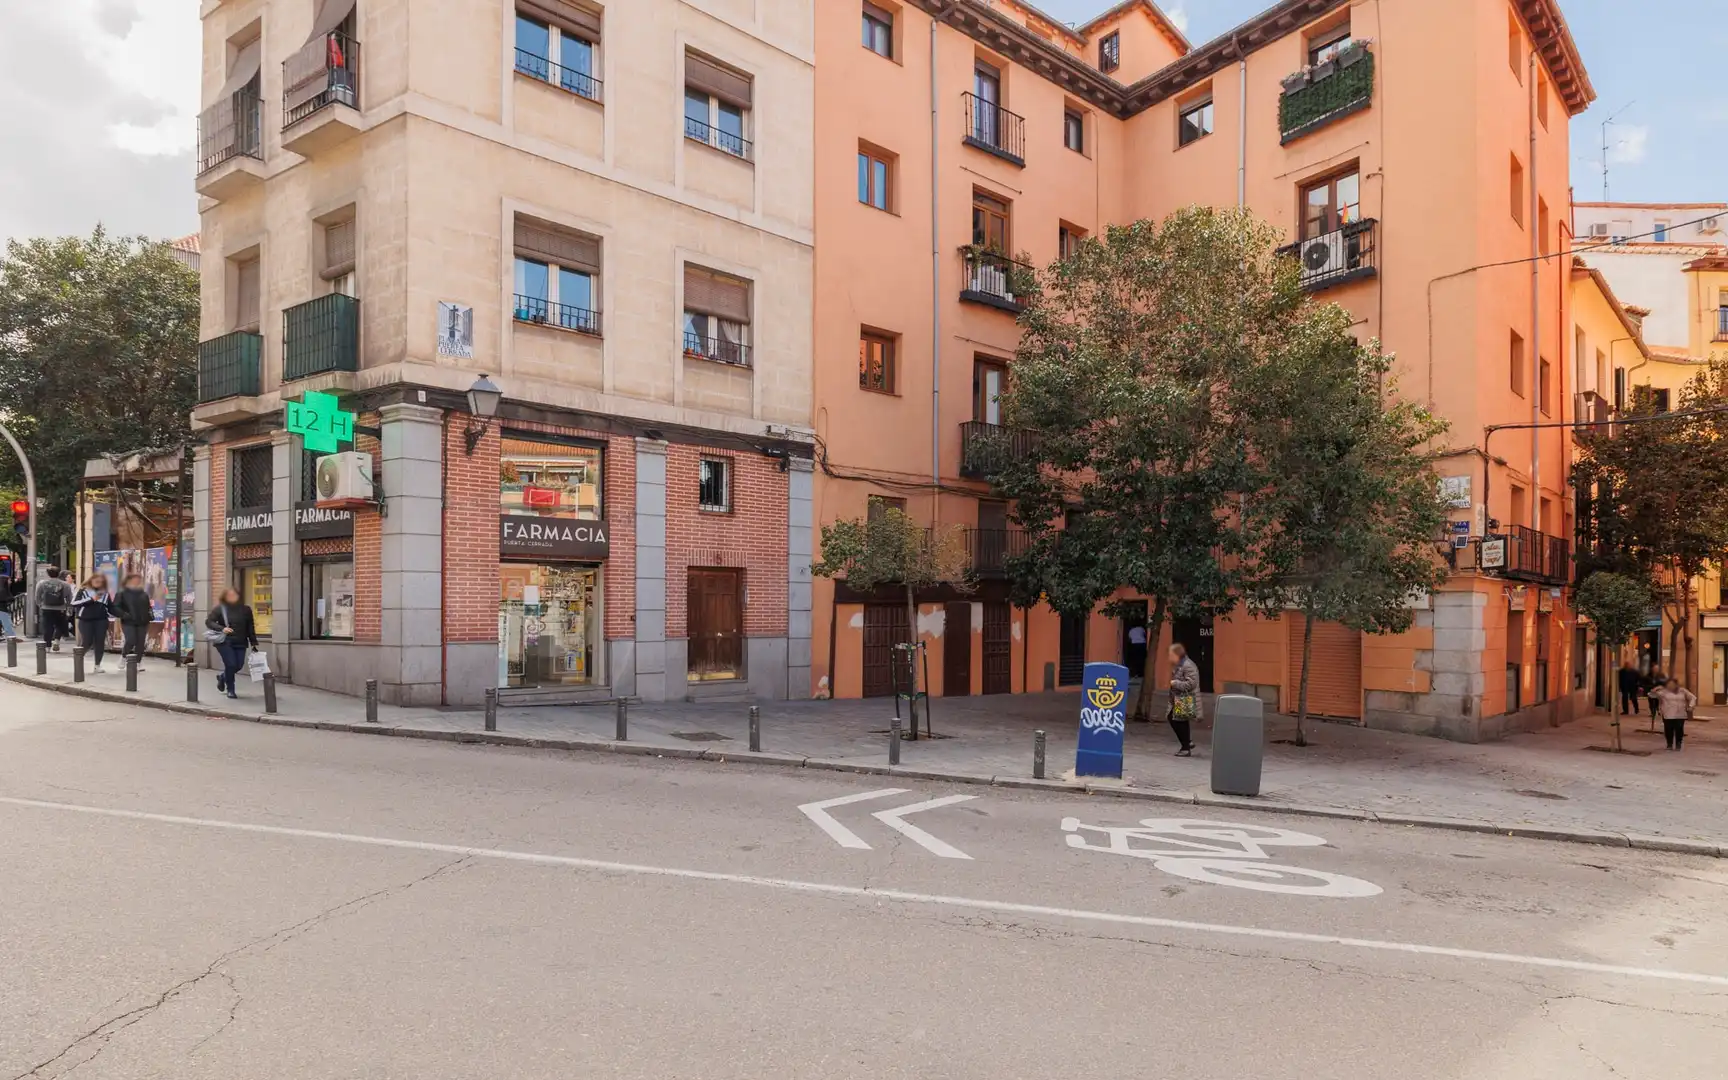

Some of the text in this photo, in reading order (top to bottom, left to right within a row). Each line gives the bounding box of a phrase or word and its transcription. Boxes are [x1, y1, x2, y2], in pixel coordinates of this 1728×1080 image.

[438, 341, 464, 351] PUERTA
[440, 347, 473, 360] CERRADA
[292, 408, 346, 435] 12 H
[226, 512, 273, 531] FARMACIA
[295, 507, 351, 525] FARMACIA
[503, 522, 606, 543] FARMACIA
[1199, 628, 1214, 636] BAR
